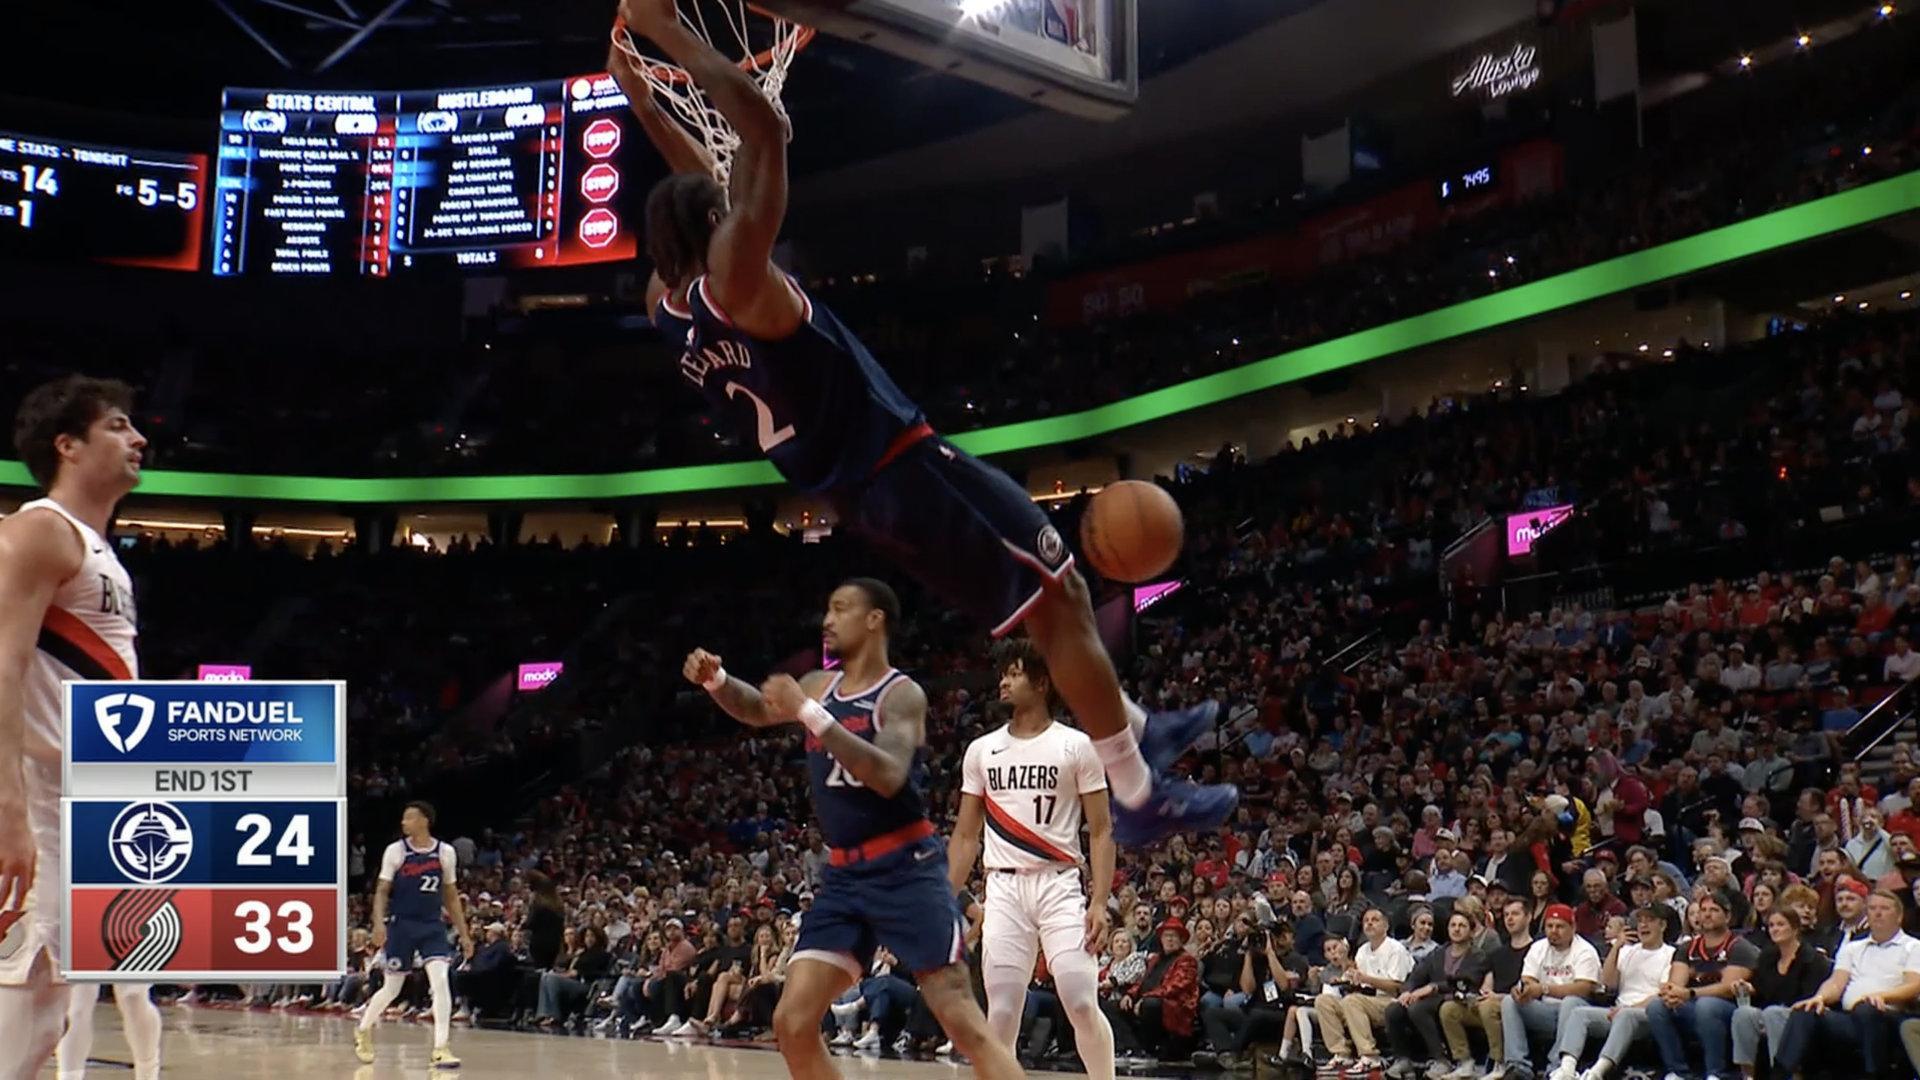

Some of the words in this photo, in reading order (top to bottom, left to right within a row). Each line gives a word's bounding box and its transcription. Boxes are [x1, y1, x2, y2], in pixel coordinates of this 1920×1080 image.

[1490, 67, 1540, 98] Lounge
[266, 93, 313, 110] STATS
[314, 95, 376, 112] CENTRAL
[587, 130, 616, 147] STOP
[18, 141, 60, 158] STATS
[72, 148, 129, 167] TONIGHT
[21, 164, 58, 196] 14
[585, 175, 615, 192] STOP
[138, 178, 197, 210] 5-5
[18, 200, 33, 228] 1
[583, 220, 613, 237] STOP
[456, 252, 497, 265] TOTALS
[725, 381, 796, 453] 2
[987, 765, 1058, 791] BLAZERS
[1033, 794, 1057, 825] 17
[419, 875, 440, 891] 22
